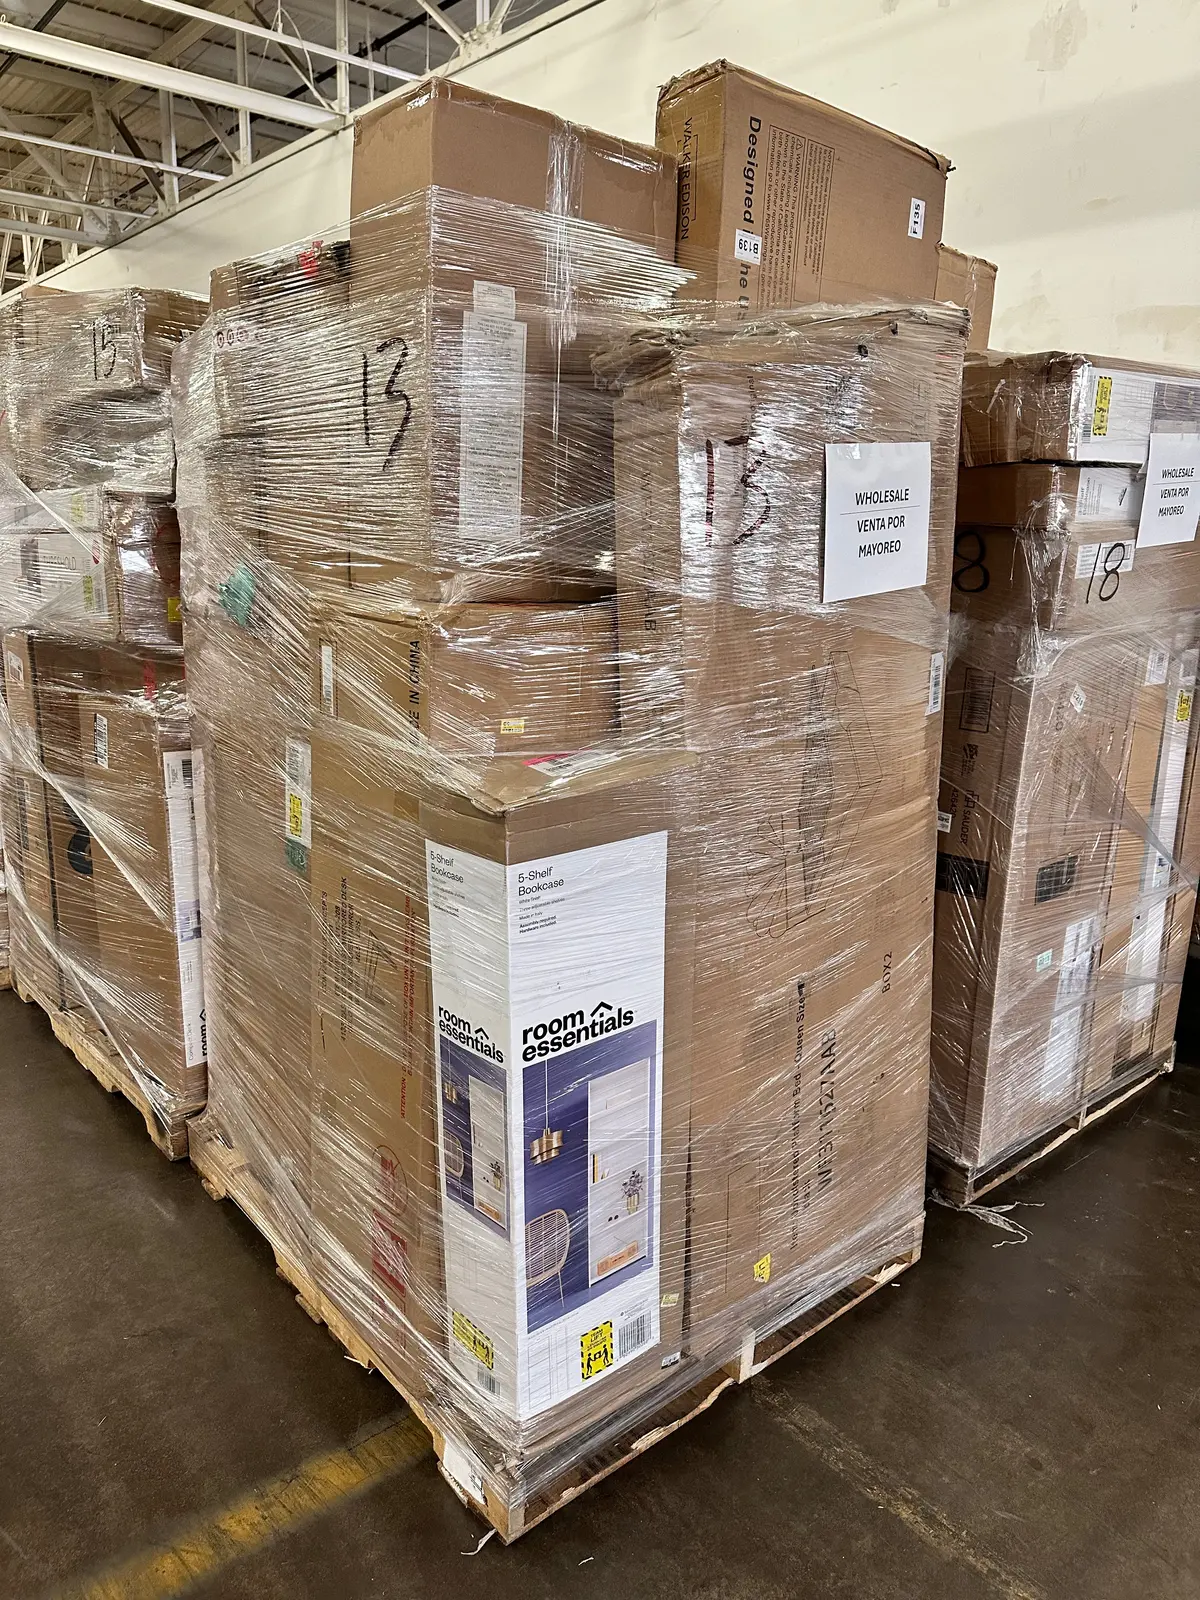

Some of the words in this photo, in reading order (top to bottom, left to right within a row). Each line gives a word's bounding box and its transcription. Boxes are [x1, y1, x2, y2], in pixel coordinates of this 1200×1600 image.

[681, 117, 693, 179] WALKER
[743, 116, 762, 224] Designed
[681, 182, 690, 240] EDISON
[912, 203, 921, 235] F135
[738, 238, 759, 254] B139
[740, 262, 751, 289] he
[93, 321, 117, 380] 15
[362, 337, 413, 472] 13
[1161, 467, 1195, 479] WHOLESALE
[704, 436, 771, 548] 13
[855, 488, 910, 506] WHOLESALE
[1160, 487, 1178, 499] VENTA
[1178, 486, 1190, 498] POR
[857, 517, 886, 533] VENTA
[887, 515, 906, 530] POR
[1158, 505, 1185, 517] MAYOREO
[858, 539, 901, 558] MAYOREO
[1085, 542, 1126, 604] 18
[408, 640, 420, 684] CHINA
[408, 690, 420, 705] IN
[960, 809, 971, 845] SAUDER
[430, 850, 454, 868] 5-Shelf
[430, 863, 464, 883] Bookcase
[518, 866, 554, 883] 5-Shelf
[518, 878, 565, 896] Bookcase
[519, 920, 539, 928] Assembly
[519, 926, 539, 934] Hardware
[882, 951, 893, 994] BOX2
[438, 1005, 471, 1034] room
[796, 997, 806, 1023] Size
[522, 1009, 585, 1045] room
[522, 1007, 635, 1062] essentials
[438, 1019, 504, 1063] essentials
[794, 1024, 805, 1062] Queen
[792, 1073, 802, 1097] Bed
[590, 1332, 604, 1343] LIFT
